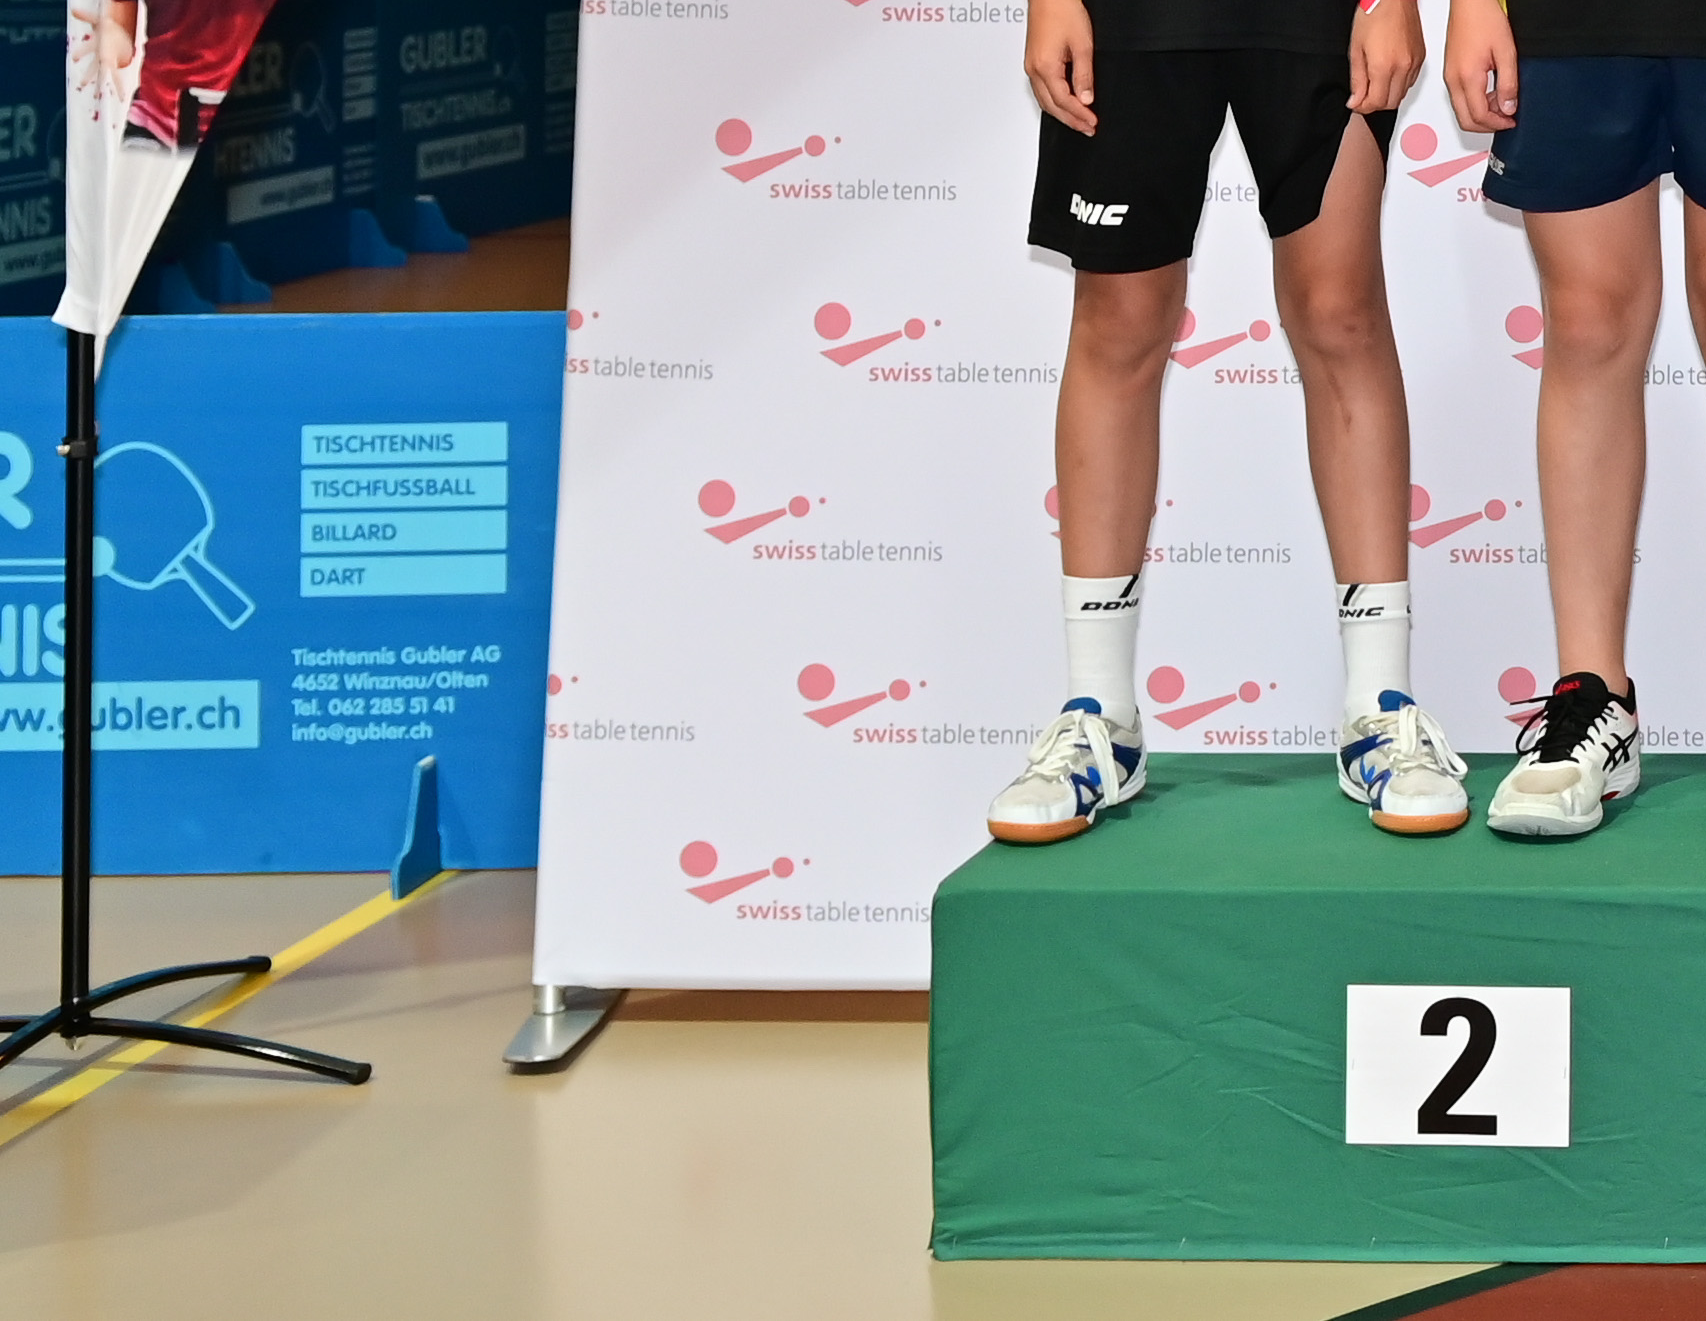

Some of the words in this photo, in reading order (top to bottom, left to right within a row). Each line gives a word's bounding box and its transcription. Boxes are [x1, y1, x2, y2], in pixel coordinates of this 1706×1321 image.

[401, 25, 488, 75] GUBLER
[313, 433, 454, 454] TISCHTENNIS
[311, 478, 475, 498] TISCHFUSSBALL
[311, 523, 397, 543] BILLARD
[310, 568, 366, 586] DART
[1081, 598, 1139, 611] DONI
[291, 646, 396, 666] Tischtennis
[401, 646, 467, 666] Gubler
[470, 645, 500, 664] AG
[291, 698, 321, 716] Tel.
[328, 698, 364, 716] 062
[370, 697, 405, 715] 285
[433, 696, 455, 714] 41
[291, 721, 432, 745] info@gubler.ch
[1417, 996, 1498, 1136] 2
